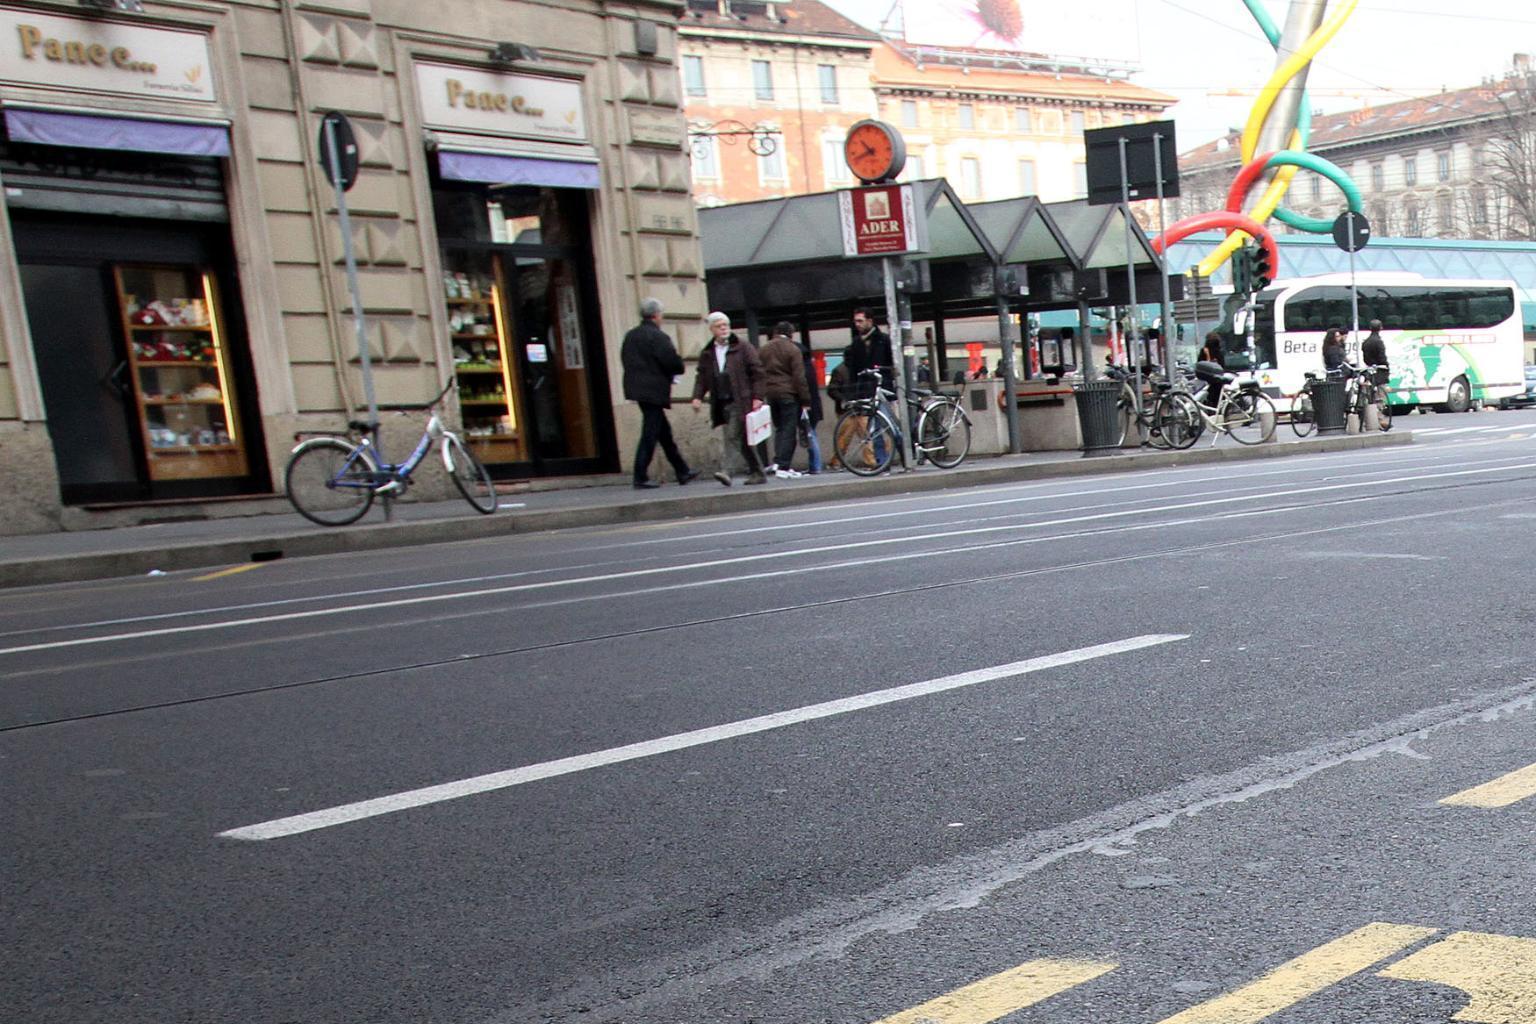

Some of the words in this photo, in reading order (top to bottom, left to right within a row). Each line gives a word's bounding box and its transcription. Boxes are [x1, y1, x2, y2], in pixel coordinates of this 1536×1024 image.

[17, 23, 107, 67] Pane
[446, 78, 508, 113] Pane
[860, 220, 900, 235] ADER
[1283, 340, 1317, 354] Beta
